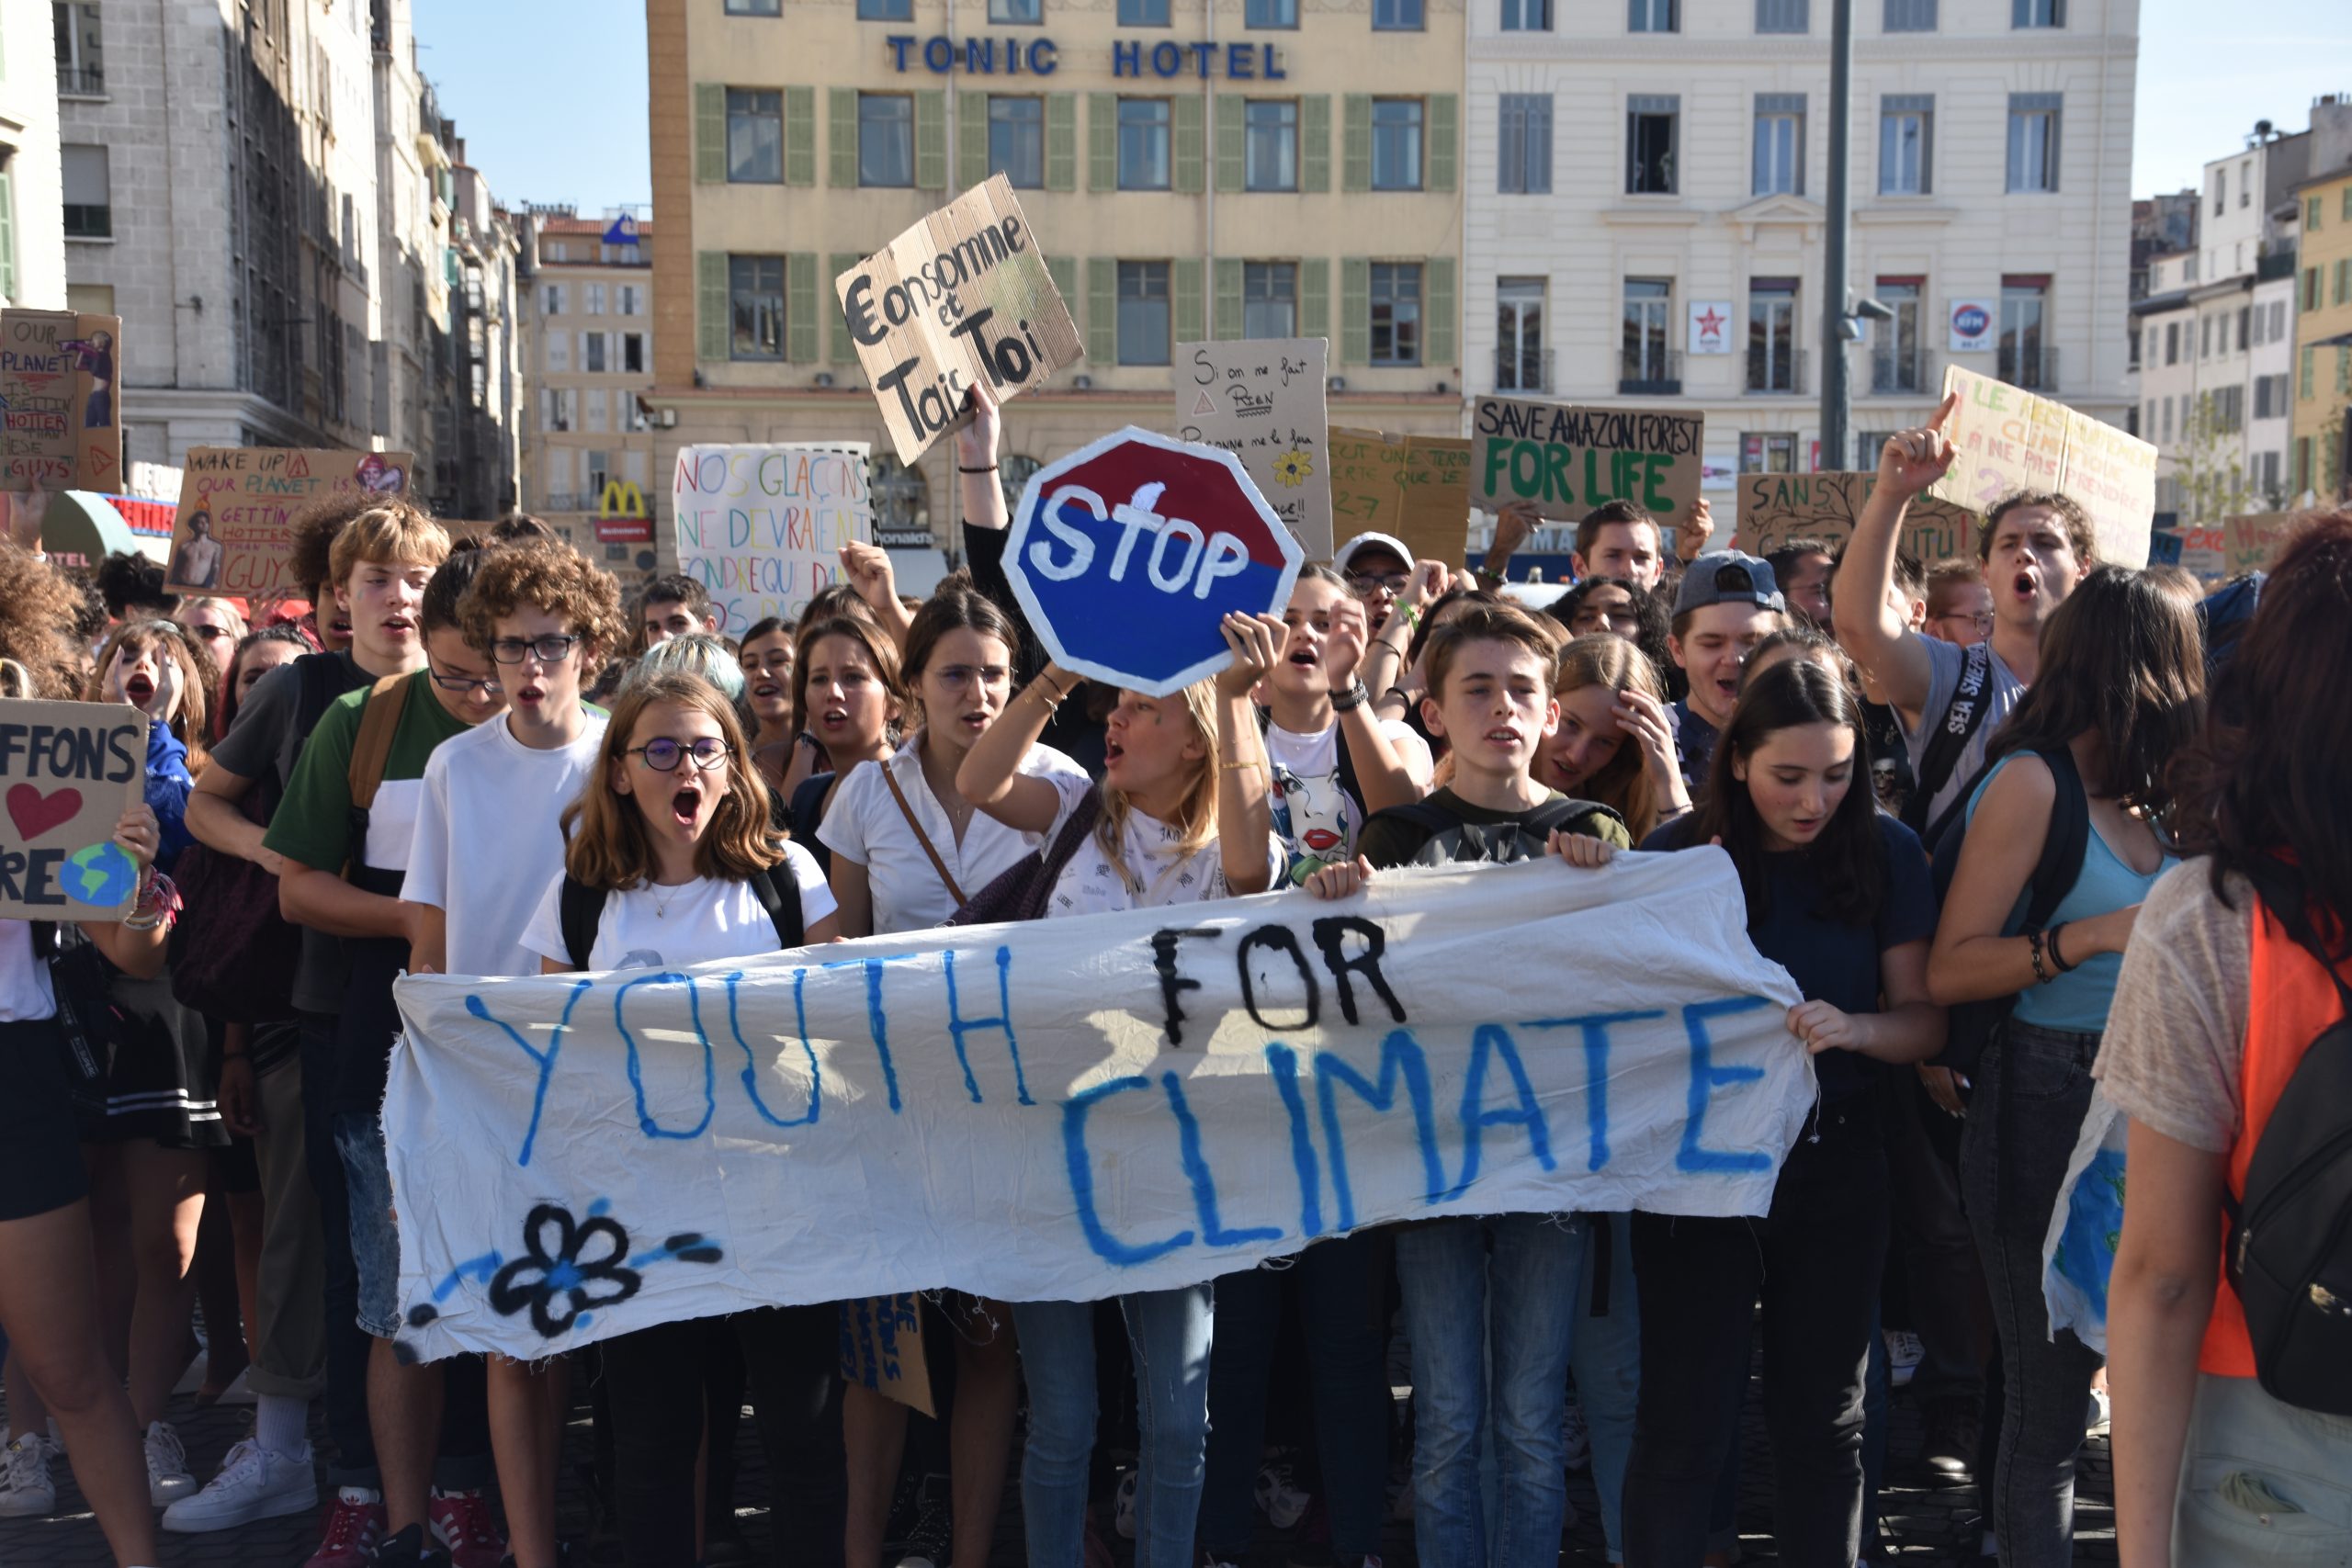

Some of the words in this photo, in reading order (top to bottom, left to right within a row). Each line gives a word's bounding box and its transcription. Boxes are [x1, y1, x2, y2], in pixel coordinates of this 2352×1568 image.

[887, 35, 1058, 75] TONIC
[1113, 40, 1286, 80] HOTEL
[938, 294, 965, 327] et
[14, 322, 57, 351] OUR
[1, 352, 74, 373] PLANET
[876, 356, 974, 442] Tais
[950, 307, 1044, 388] Toi
[1972, 382, 2008, 412] LE
[5, 413, 67, 435] HOTTER
[1478, 401, 1547, 441] SAVE
[1549, 408, 1635, 450] AMAZON
[1639, 414, 1704, 456] FOREST
[0, 436, 42, 456] HESE
[187, 453, 248, 473] WAKE
[1988, 436, 2014, 464] NE
[2025, 449, 2058, 477] PAS
[197, 477, 236, 494] OUR
[245, 475, 321, 494] PLANET
[676, 454, 750, 497] NOS
[759, 454, 868, 504] GLAÇONS
[1331, 465, 1377, 481] ERTE
[1484, 437, 1574, 503] FOR
[1584, 447, 1676, 513] LIFE
[1753, 478, 1831, 510] SANS
[222, 527, 293, 539] HOTTER
[229, 543, 260, 551] THAN
[679, 510, 717, 549] NE
[729, 507, 871, 554] DEVRAIENT
[1028, 484, 1250, 600] STOP
[225, 554, 296, 589] GUY
[763, 558, 805, 595] QUE
[813, 562, 850, 596] DAN
[1948, 701, 1974, 735] SEA
[465, 944, 1039, 1168] YOUTH
[1149, 916, 1407, 1048] FOR
[1061, 996, 1773, 1268] CLIMATE
